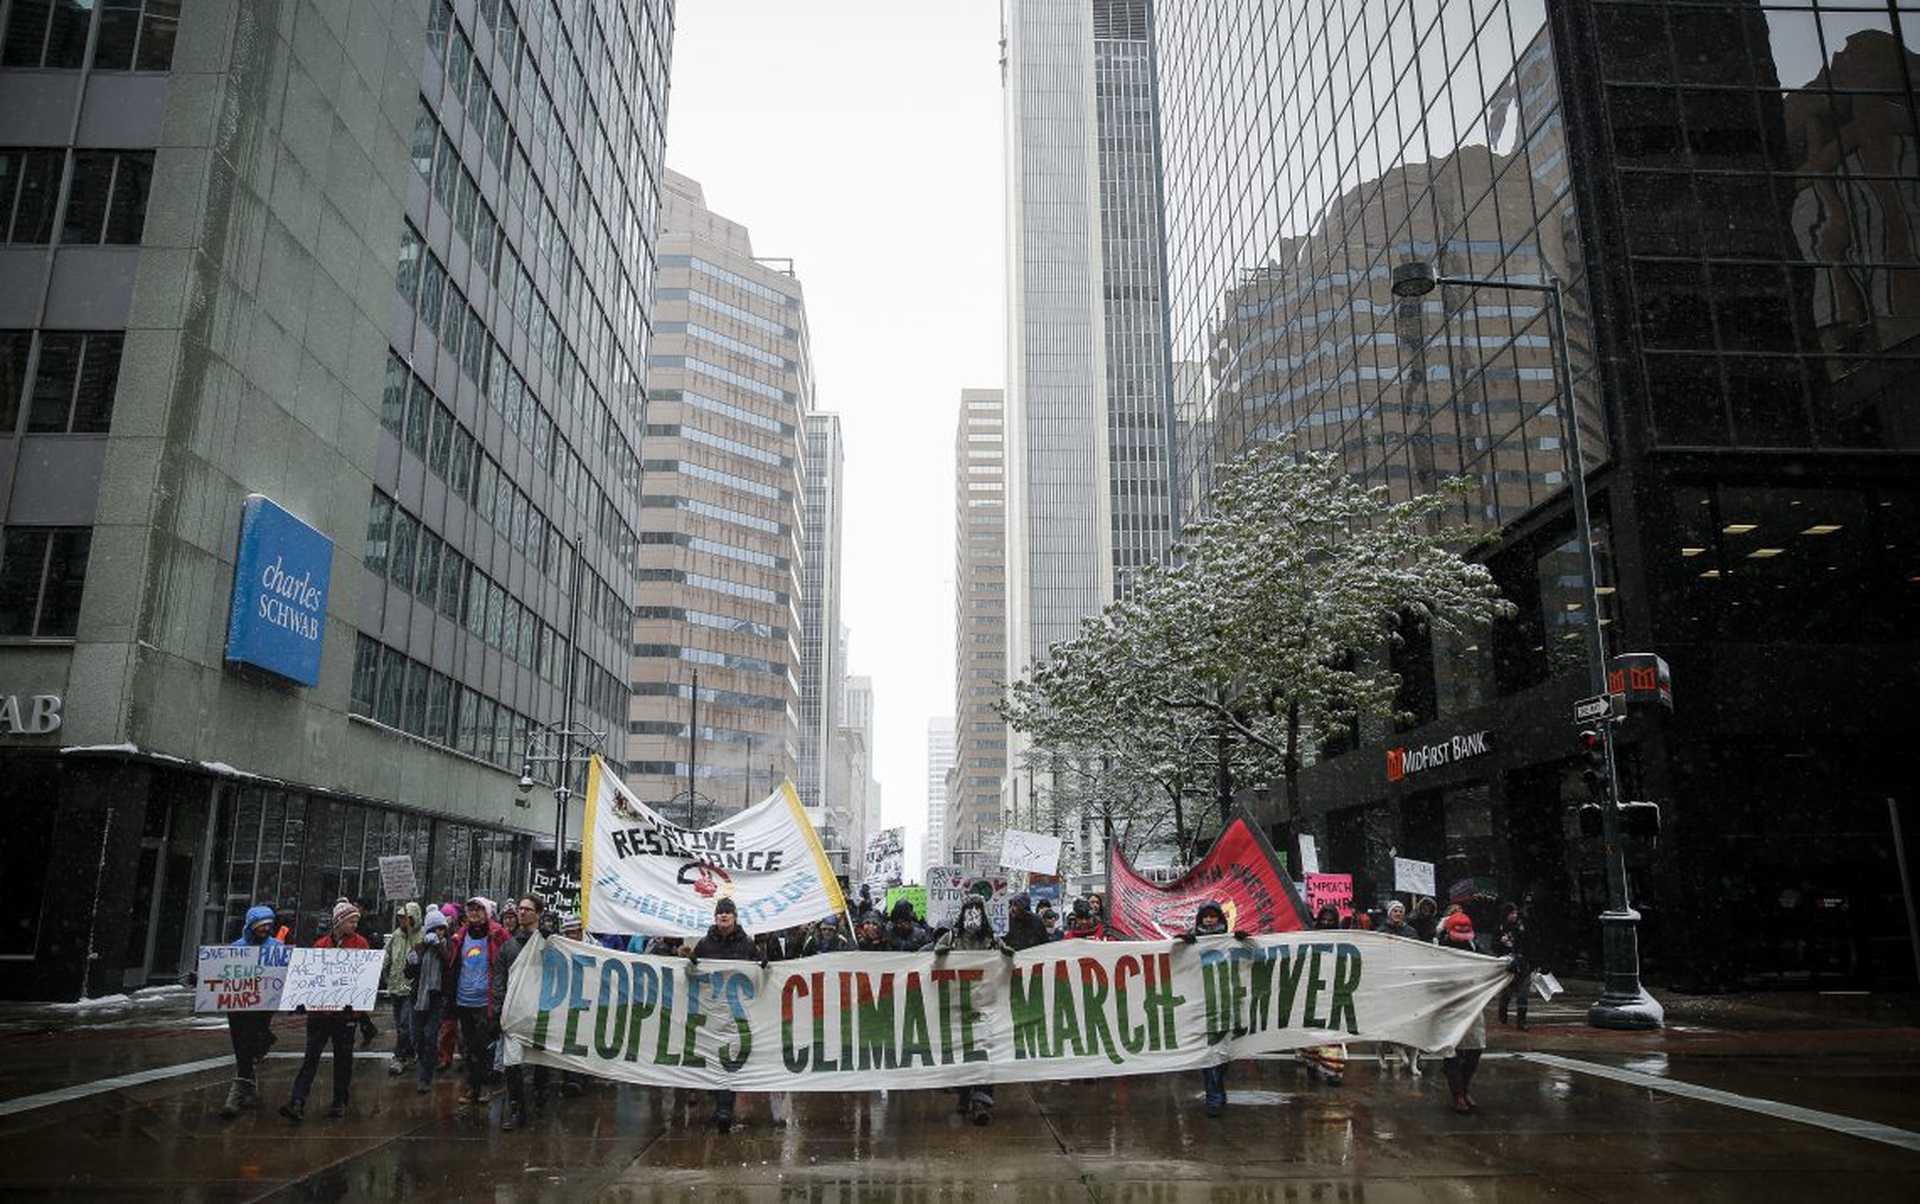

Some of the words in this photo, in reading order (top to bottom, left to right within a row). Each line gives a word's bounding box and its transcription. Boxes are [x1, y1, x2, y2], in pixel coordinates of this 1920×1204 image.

[261, 556, 322, 611] charles
[258, 593, 318, 641] SCHWAB
[0, 694, 61, 733] AB
[1452, 731, 1489, 760] BANK
[611, 828, 783, 872] RESIANCE
[535, 868, 556, 887] For
[1306, 874, 1352, 893] IMPEACH
[931, 889, 960, 900] FUTU
[217, 963, 264, 979] SEND
[203, 976, 261, 992] TRUMP
[262, 976, 283, 991] TO
[216, 991, 262, 1009] MARS
[534, 947, 754, 1073] PEOPLE'S
[781, 969, 988, 1074] CLIMATE
[1010, 953, 1186, 1065] MARCH
[1200, 942, 1363, 1046] DENVER
